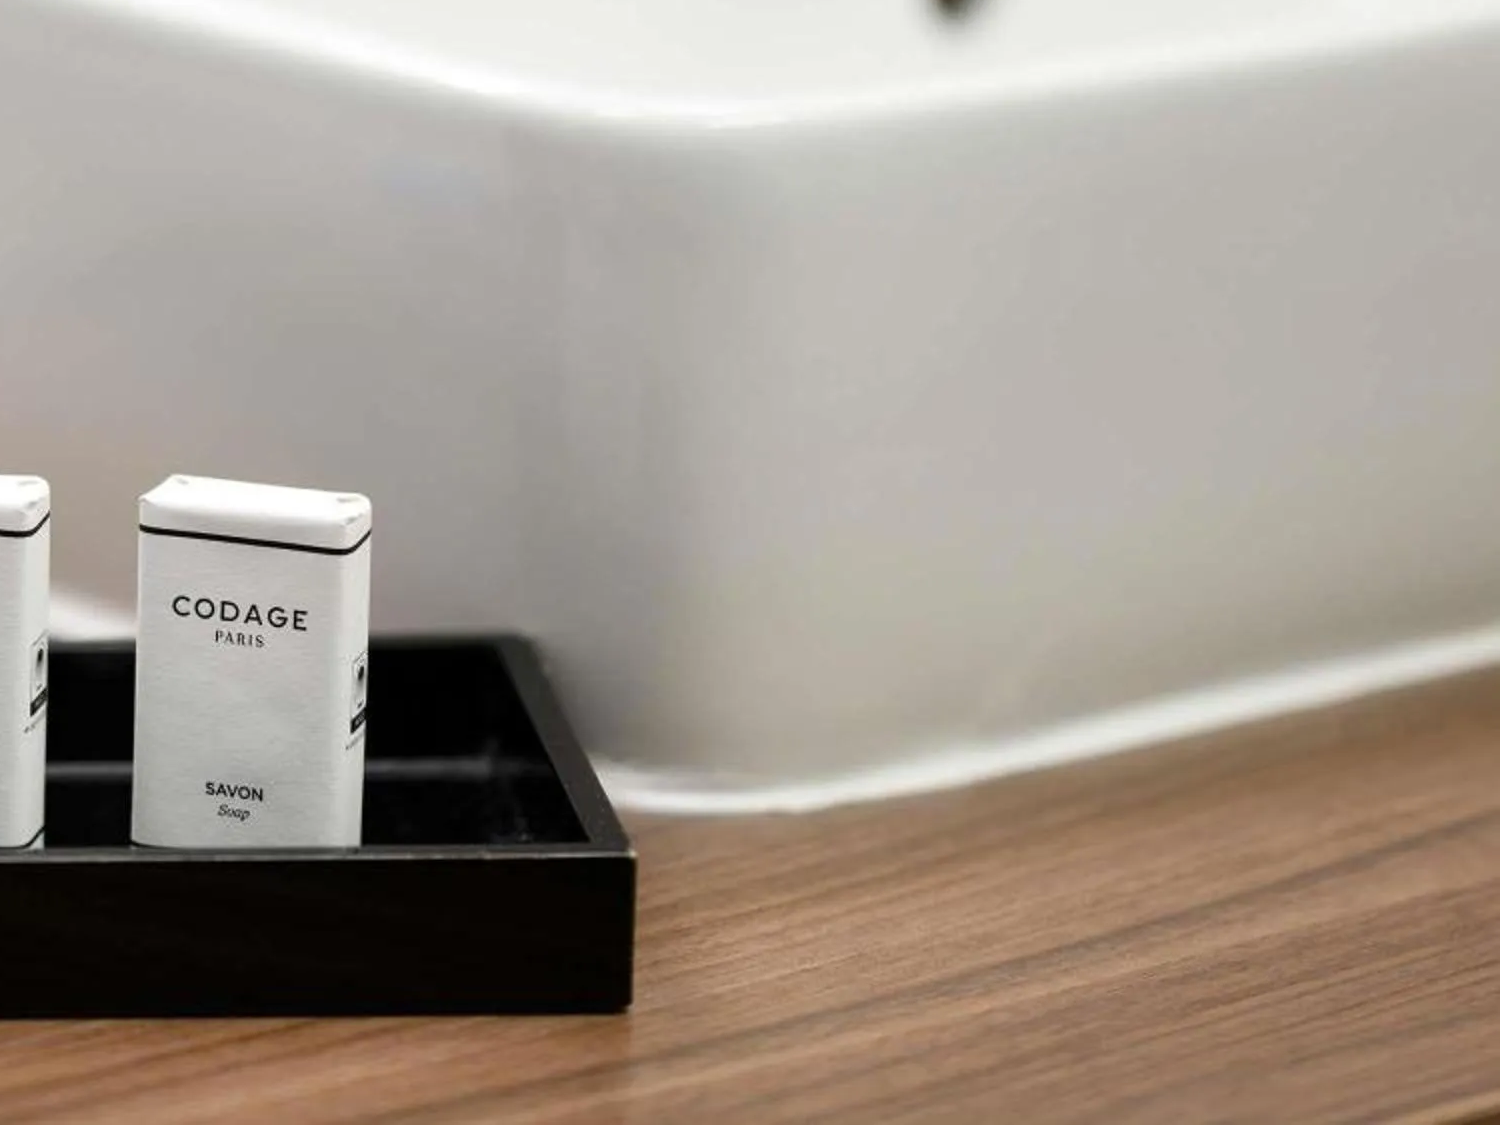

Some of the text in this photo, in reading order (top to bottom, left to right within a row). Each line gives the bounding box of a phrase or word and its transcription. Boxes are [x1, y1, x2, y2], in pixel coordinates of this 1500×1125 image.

[172, 595, 309, 632] CODAGE
[215, 629, 266, 648] PARIS
[205, 782, 264, 802] SAVON
[217, 804, 251, 822] Soap
